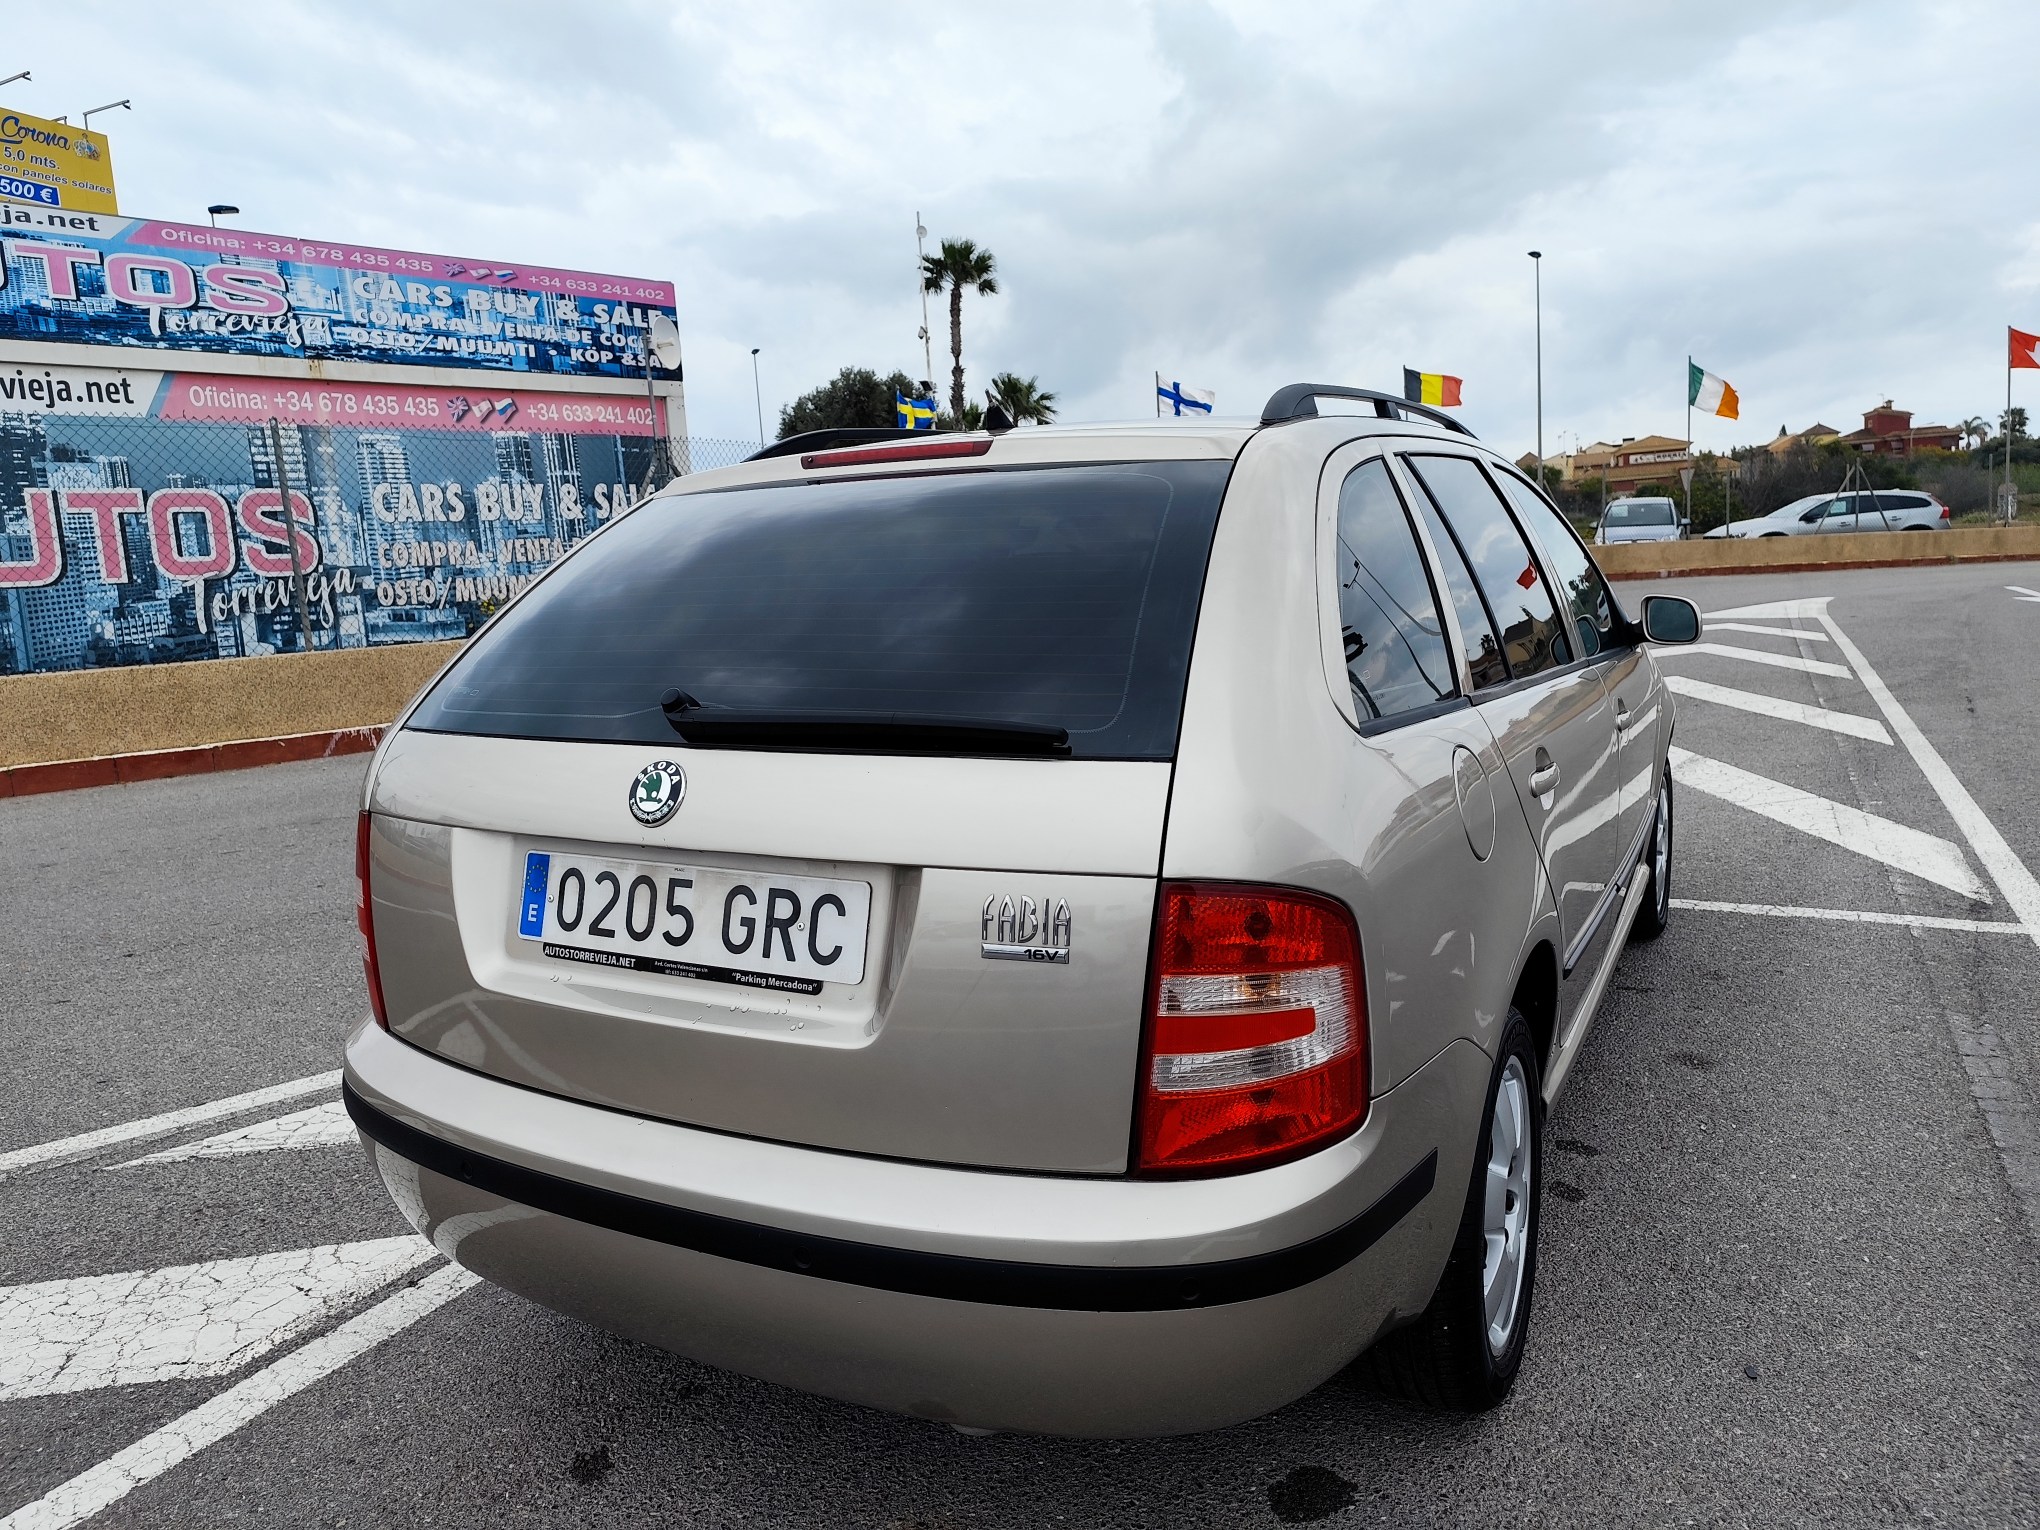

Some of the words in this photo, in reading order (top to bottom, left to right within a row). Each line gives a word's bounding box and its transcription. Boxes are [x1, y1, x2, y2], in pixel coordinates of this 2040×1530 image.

[1, 115, 71, 150] Corona
[4, 146, 25, 162] 5,0
[30, 154, 60, 170] mts.
[22, 168, 68, 185] paneles
[71, 179, 112, 195] solares
[40, 188, 53, 203] €
[0, 204, 100, 232] ja.net
[160, 228, 246, 249] Oficina:
[253, 240, 296, 255] +34
[302, 245, 344, 261] 678
[349, 251, 390, 267] 435
[395, 257, 433, 272] 435
[0, 239, 290, 318] TOS
[529, 274, 562, 288] +34
[565, 279, 598, 293] 633
[602, 283, 632, 297] 241
[635, 287, 665, 301] 402
[353, 276, 453, 308] CARS
[467, 288, 541, 317] BUY
[556, 299, 580, 321] &
[147, 303, 330, 348] Torrevieja
[354, 308, 465, 333] COMPRA
[566, 329, 593, 344] DE
[599, 331, 648, 348] COC
[570, 345, 614, 364] KÖP
[0, 369, 135, 409] vieja.net
[188, 384, 269, 411] Oficina:
[273, 391, 314, 412] +34
[318, 392, 358, 414] 678
[362, 394, 400, 416] 435
[404, 396, 440, 417] 435
[527, 402, 559, 422] +34
[562, 404, 594, 423] 633
[596, 405, 625, 424] 241
[627, 407, 654, 425] 402
[372, 482, 466, 523] CARS
[476, 482, 545, 522] BUY
[559, 482, 585, 520] &
[378, 540, 481, 569] COMPRA
[500, 537, 565, 564] VENTA
[182, 564, 357, 635] Torreveja
[527, 903, 538, 923] E
[556, 867, 695, 948] 0205
[721, 884, 847, 966] GRC
[982, 893, 1072, 947] FABIA
[544, 945, 636, 968] AUTOSTORREVIEJA.NET
[1023, 948, 1060, 962] 16V
